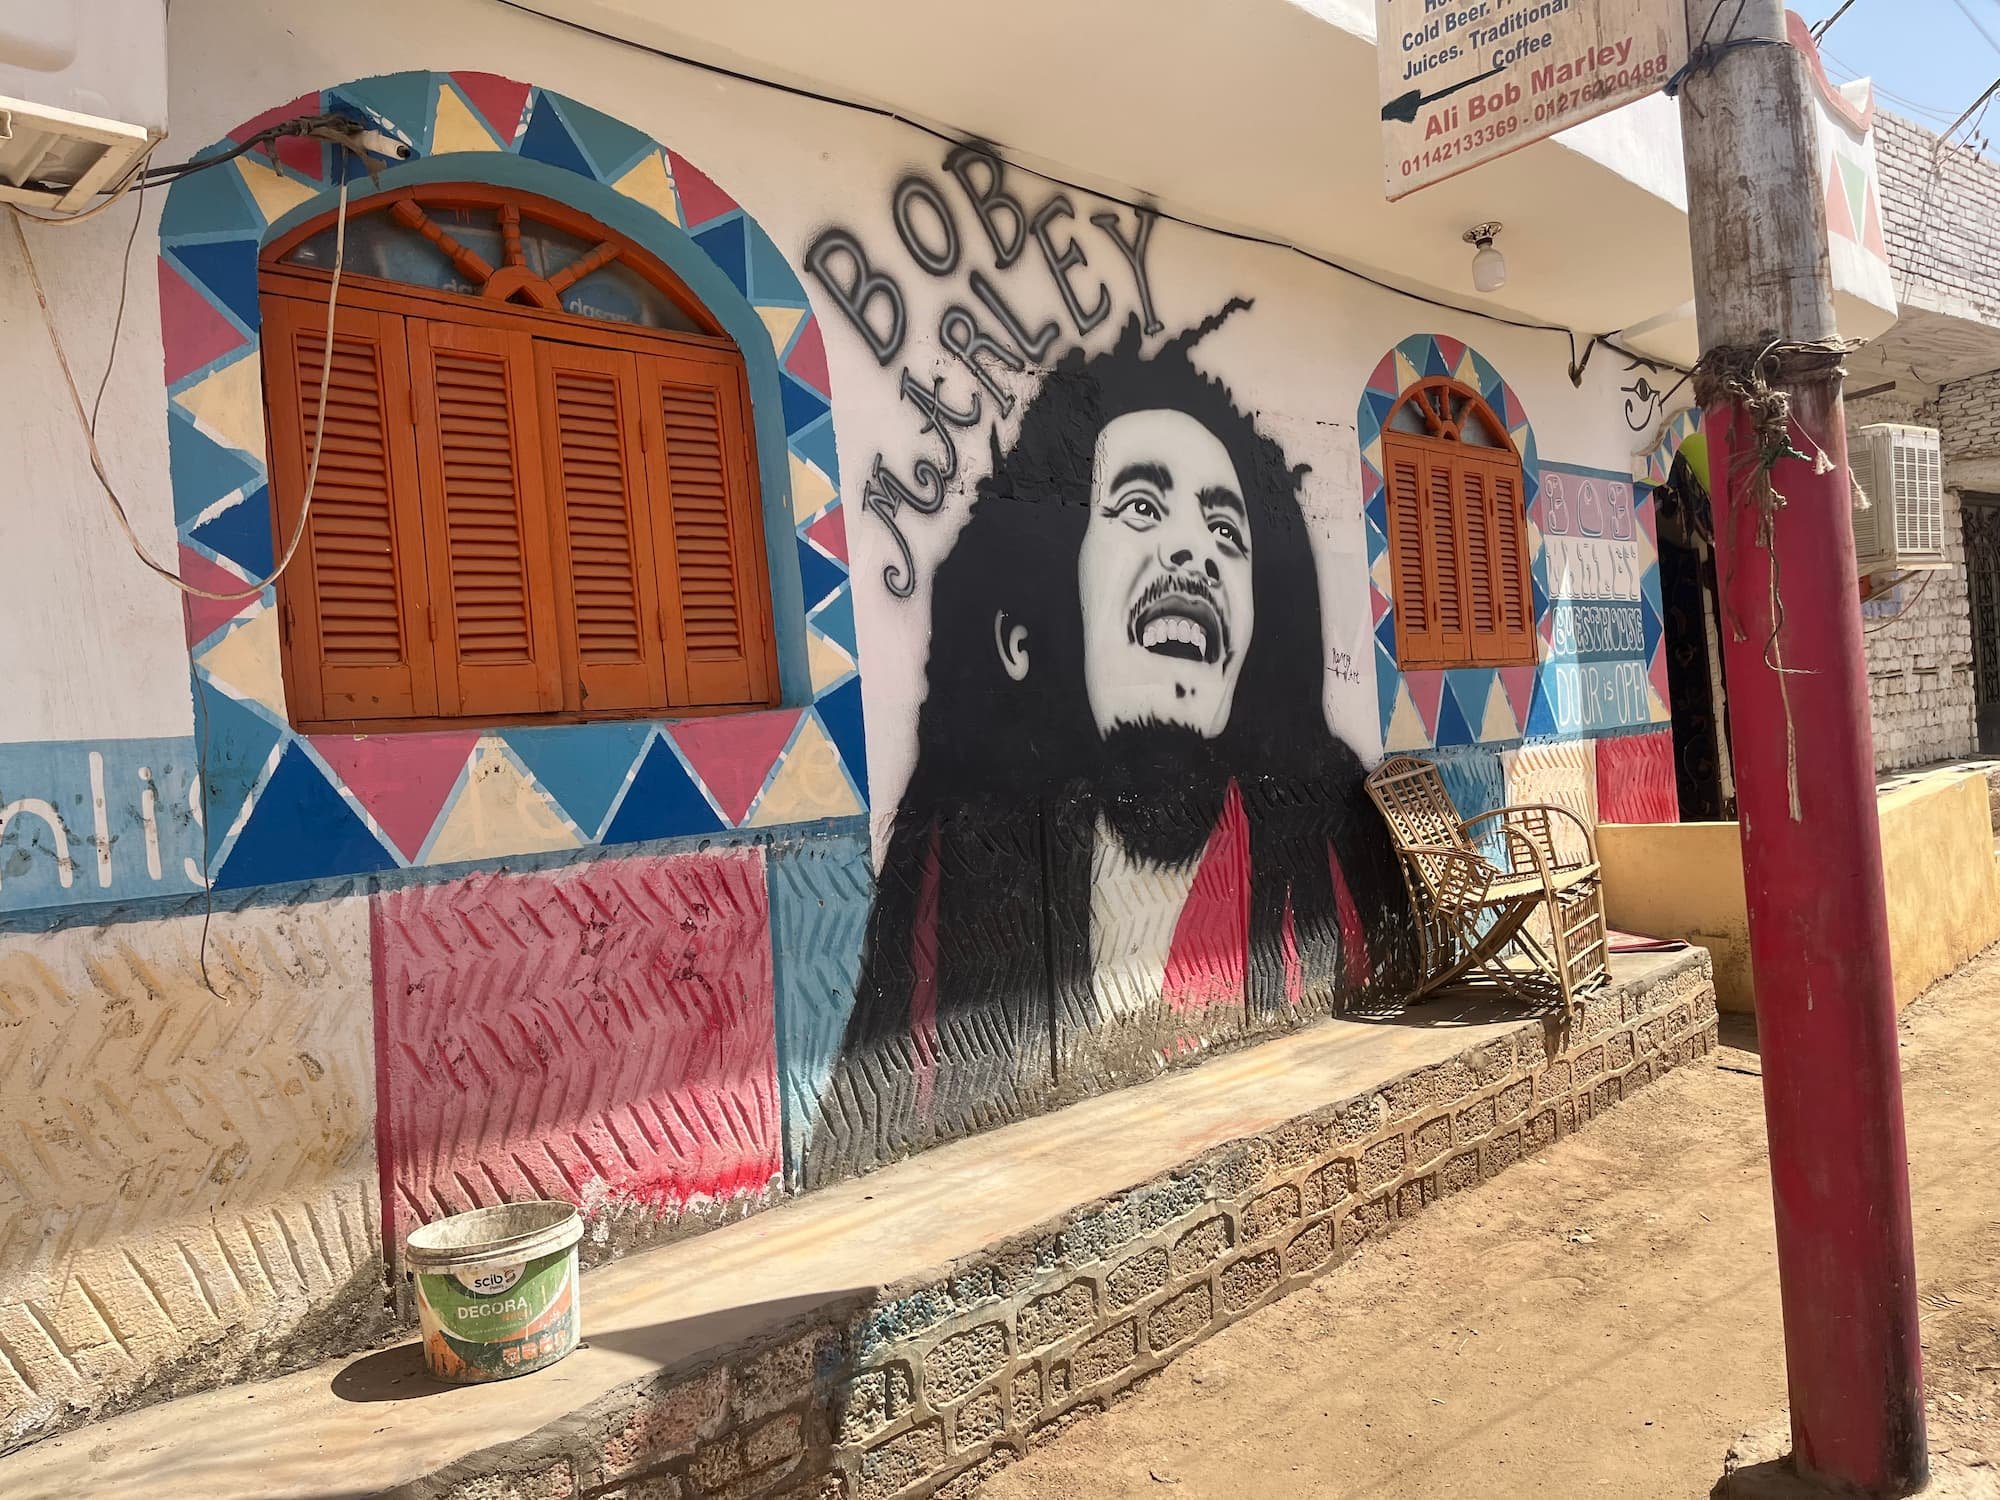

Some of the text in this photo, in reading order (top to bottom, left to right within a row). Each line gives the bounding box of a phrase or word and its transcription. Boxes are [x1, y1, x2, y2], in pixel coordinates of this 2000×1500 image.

[1402, 20, 1440, 51] Cold
[1469, 0, 1569, 50] Traditional
[1492, 33, 1552, 70] Coffee
[1424, 37, 1633, 141] Ali Bob Marley
[1401, 115, 1519, 177] 01142133369
[804, 141, 1027, 367] BOB
[862, 192, 1166, 598] MARLEY
[1552, 606, 1645, 655] GUESTHOUSE
[1556, 662, 1648, 727] DOOR is OPEN
[474, 1274, 503, 1288] scib
[457, 1296, 528, 1320] DECORA
